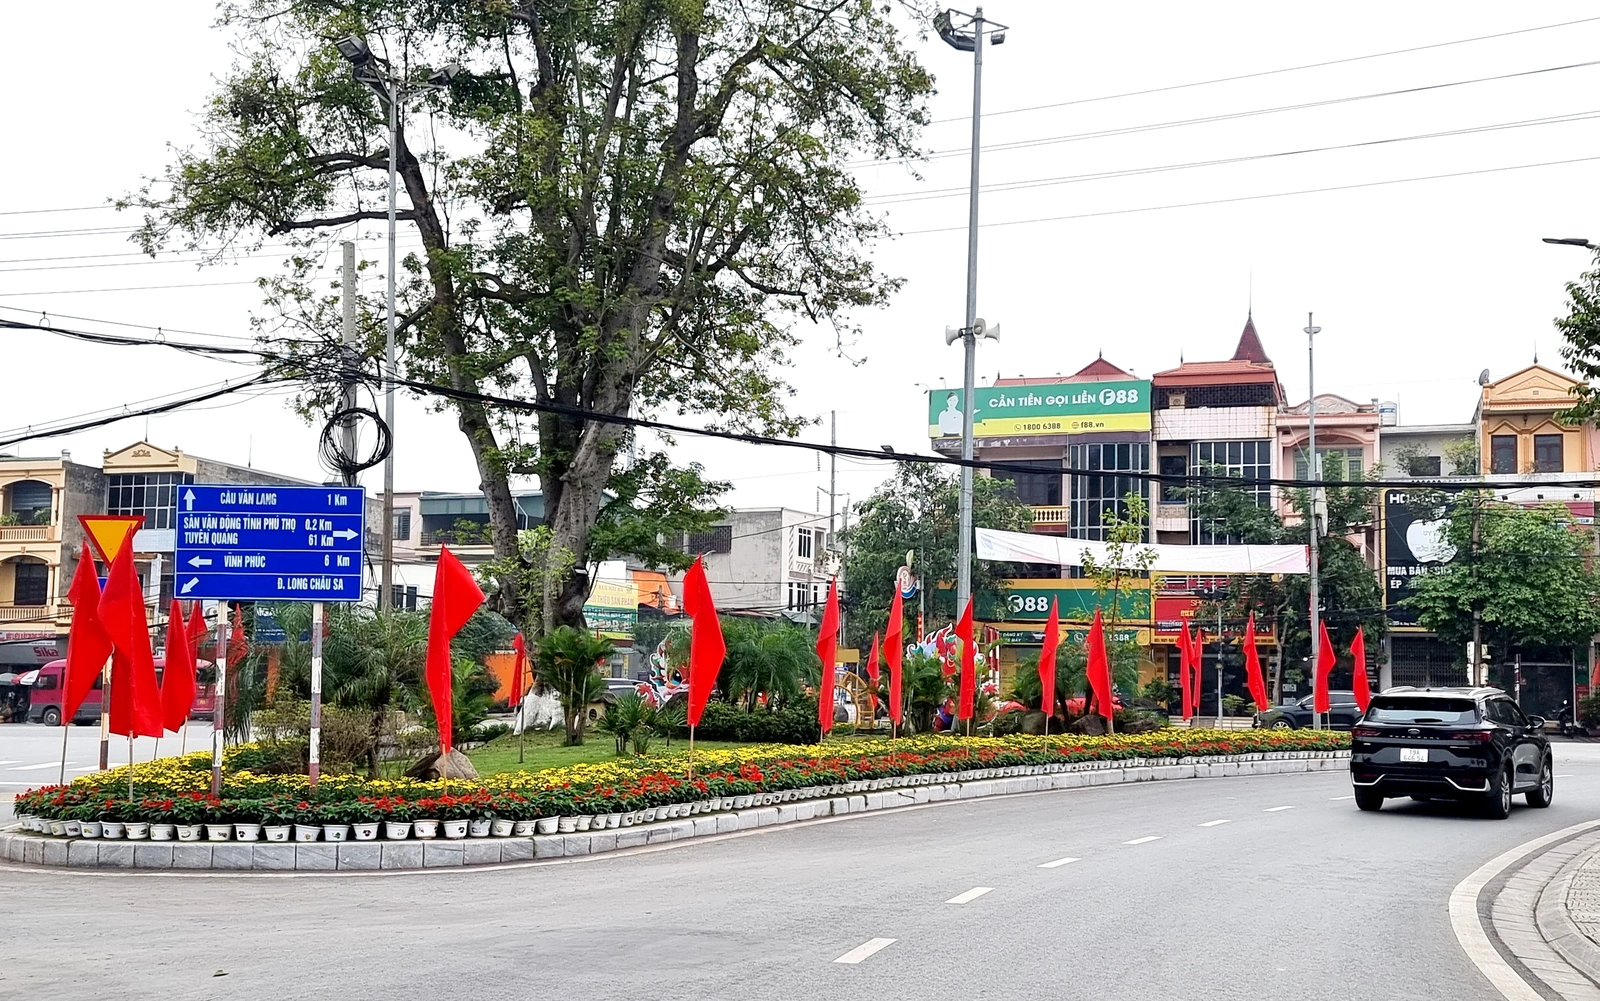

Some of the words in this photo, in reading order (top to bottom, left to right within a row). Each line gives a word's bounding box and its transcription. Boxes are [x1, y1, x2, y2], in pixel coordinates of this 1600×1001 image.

[989, 393, 1015, 408] CẦN
[1018, 392, 1042, 407] TIỀN
[1046, 395, 1069, 408] GỌI
[1072, 389, 1096, 405] LIỀN
[1099, 388, 1139, 406] F88
[1023, 423, 1041, 431] 1800
[1042, 422, 1061, 430] 6388
[1081, 421, 1105, 429] f88.vn
[238, 489, 254, 505] VĂN
[256, 492, 277, 506] LANG
[327, 494, 332, 506] 1
[334, 494, 347, 506] Km
[183, 513, 200, 529] SÂN
[201, 513, 218, 532] VẬN
[219, 514, 241, 532] ĐỘNG
[243, 514, 262, 530] TỈNH
[263, 515, 280, 530] PHÚ
[281, 518, 297, 533] THỌ
[305, 518, 317, 531] 0.2
[319, 518, 332, 531] Km
[184, 529, 209, 544] TUYÊN
[211, 532, 238, 546] QUANG
[308, 533, 318, 546] 61
[321, 534, 334, 547] Km
[224, 551, 243, 568] VĨNH
[244, 552, 266, 568] PHÚC
[324, 554, 330, 567] 6
[337, 555, 350, 567] Km
[1387, 566, 1407, 576] MUA
[1408, 563, 1428, 576] BÁN
[277, 578, 285, 590] Đ.
[287, 578, 308, 590] LONG
[333, 578, 344, 590] SA
[1390, 577, 1403, 589] ÉP
[33, 646, 60, 657] Sika
